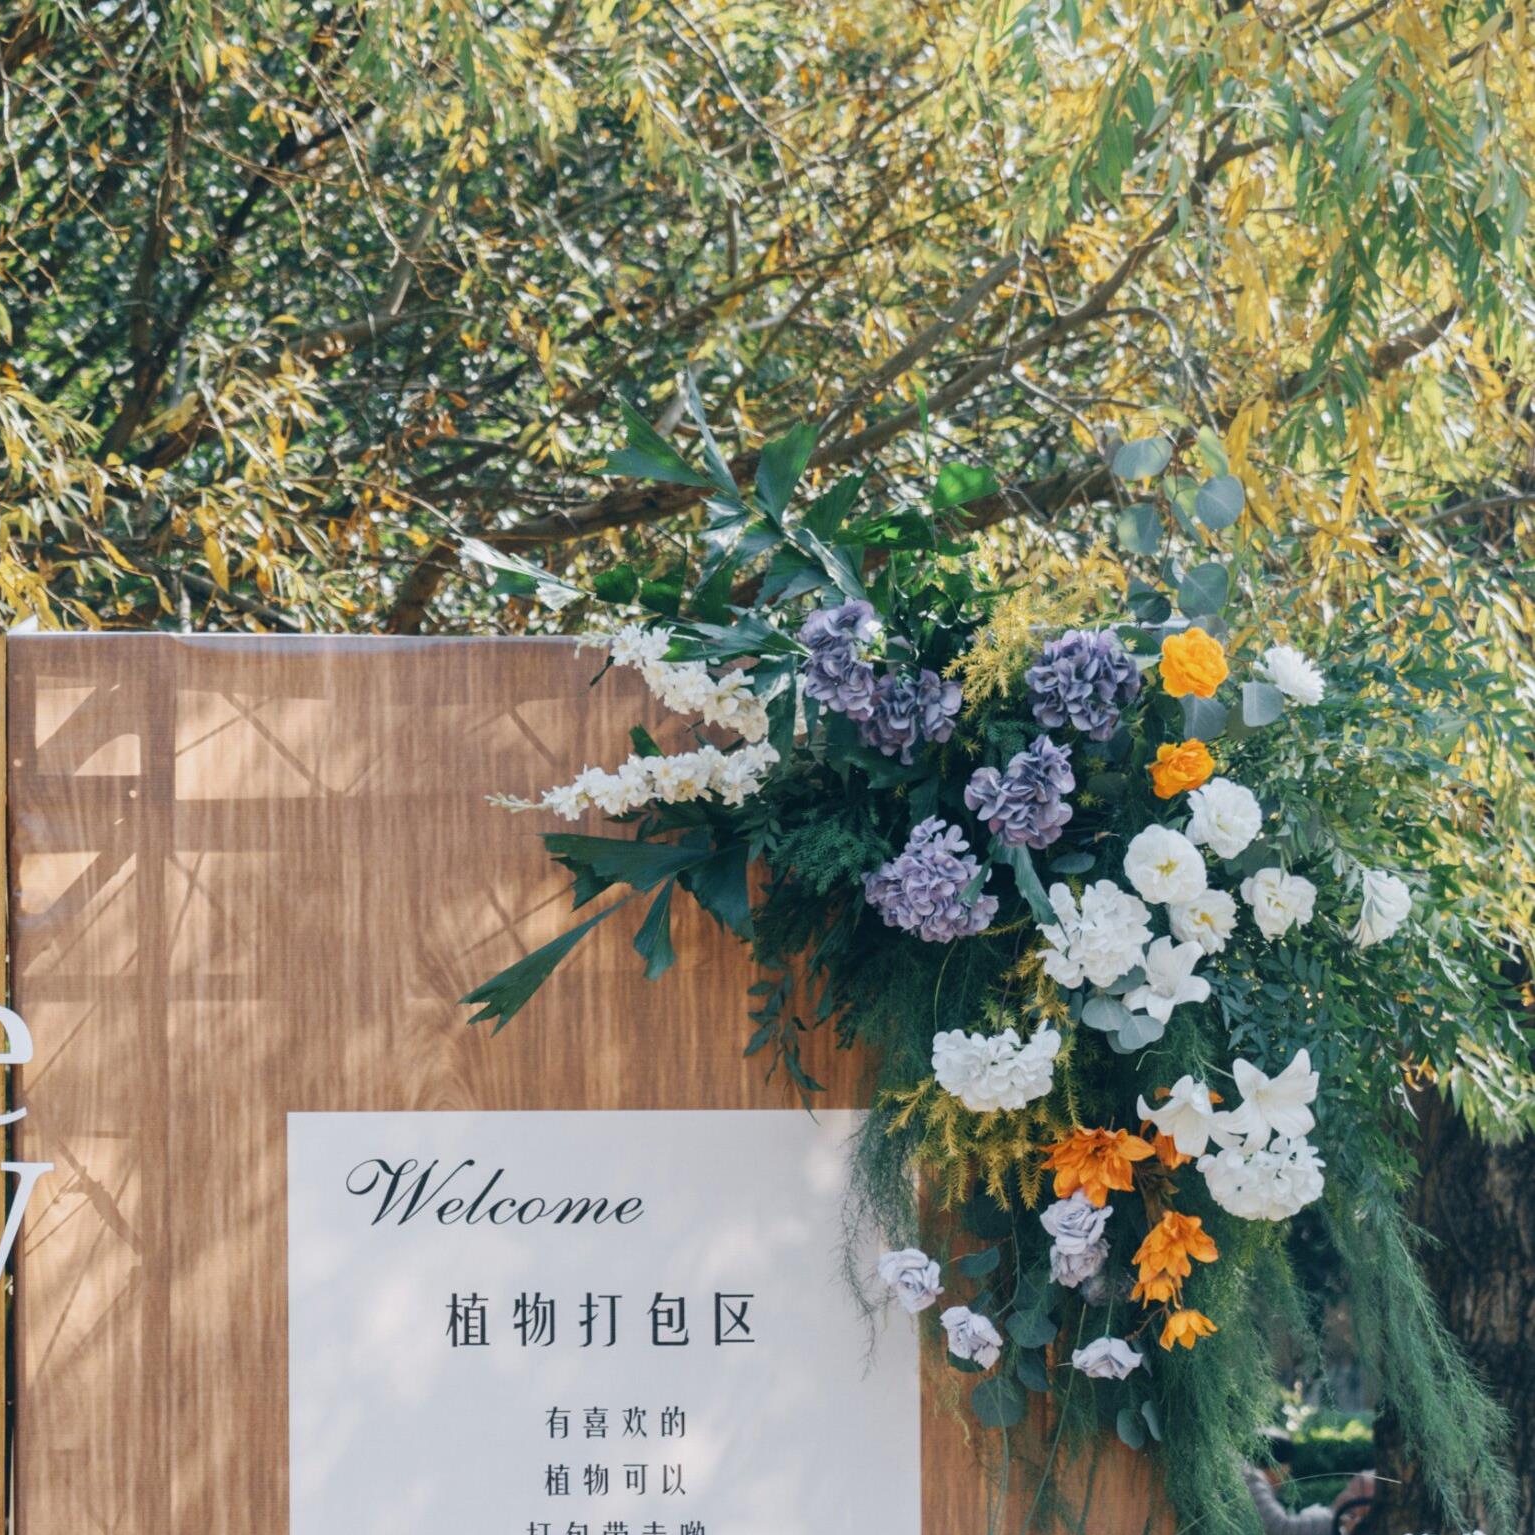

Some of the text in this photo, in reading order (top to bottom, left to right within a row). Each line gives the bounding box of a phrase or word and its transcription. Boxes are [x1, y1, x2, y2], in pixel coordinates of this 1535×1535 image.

[345, 1158, 645, 1227] Welcome
[444, 1290, 756, 1349] 植物打包区
[544, 1404, 687, 1440] 有喜欢的
[543, 1462, 687, 1497] 植物可以
